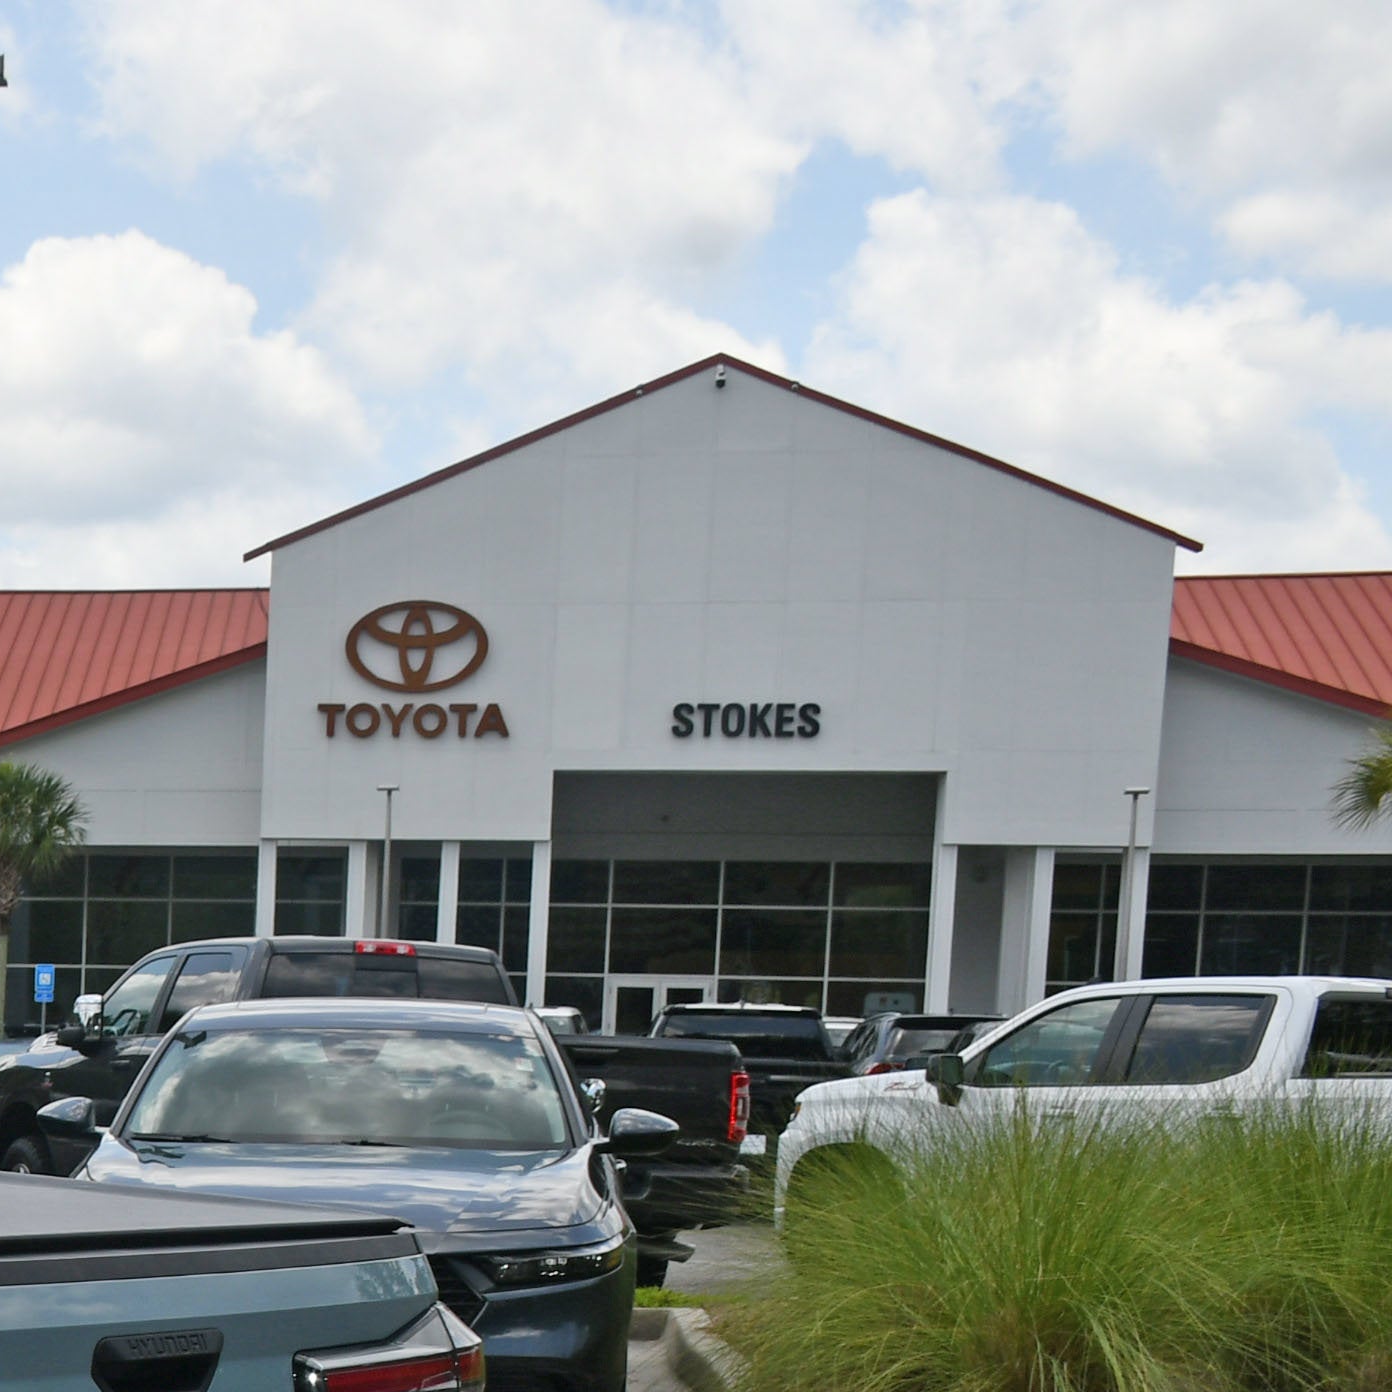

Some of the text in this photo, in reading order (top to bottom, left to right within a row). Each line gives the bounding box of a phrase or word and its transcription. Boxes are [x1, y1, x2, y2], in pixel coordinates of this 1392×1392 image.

[317, 703, 510, 739] TOYOTA
[671, 702, 822, 739] STOKES
[127, 1333, 208, 1356] HYUNDAI
